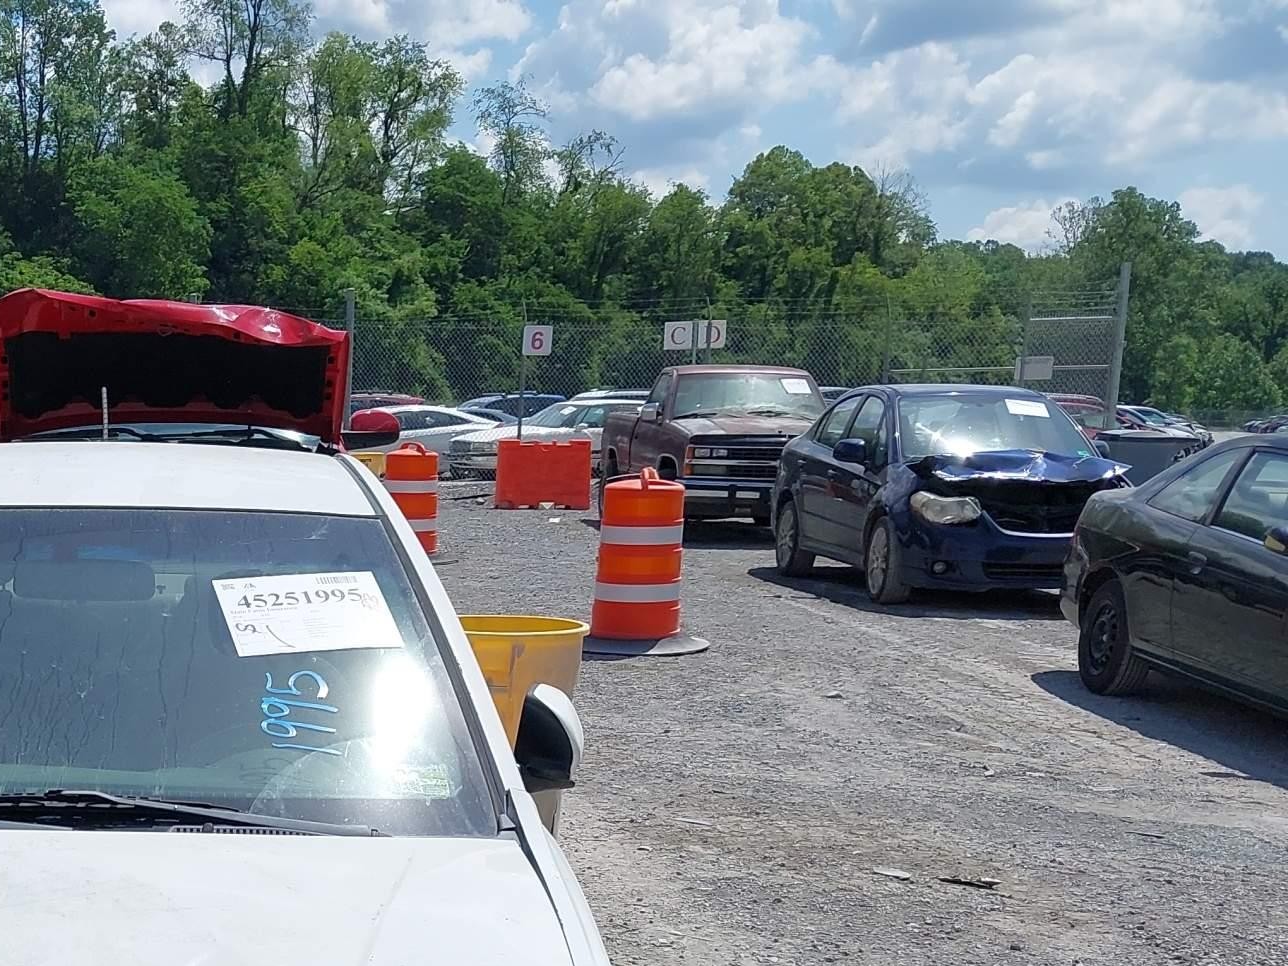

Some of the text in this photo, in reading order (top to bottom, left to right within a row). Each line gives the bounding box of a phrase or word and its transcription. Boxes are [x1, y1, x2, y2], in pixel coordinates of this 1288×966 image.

[530, 331, 544, 350] 6
[670, 325, 721, 345] C D
[237, 588, 363, 609] 45251995
[260, 669, 343, 756] 1995
